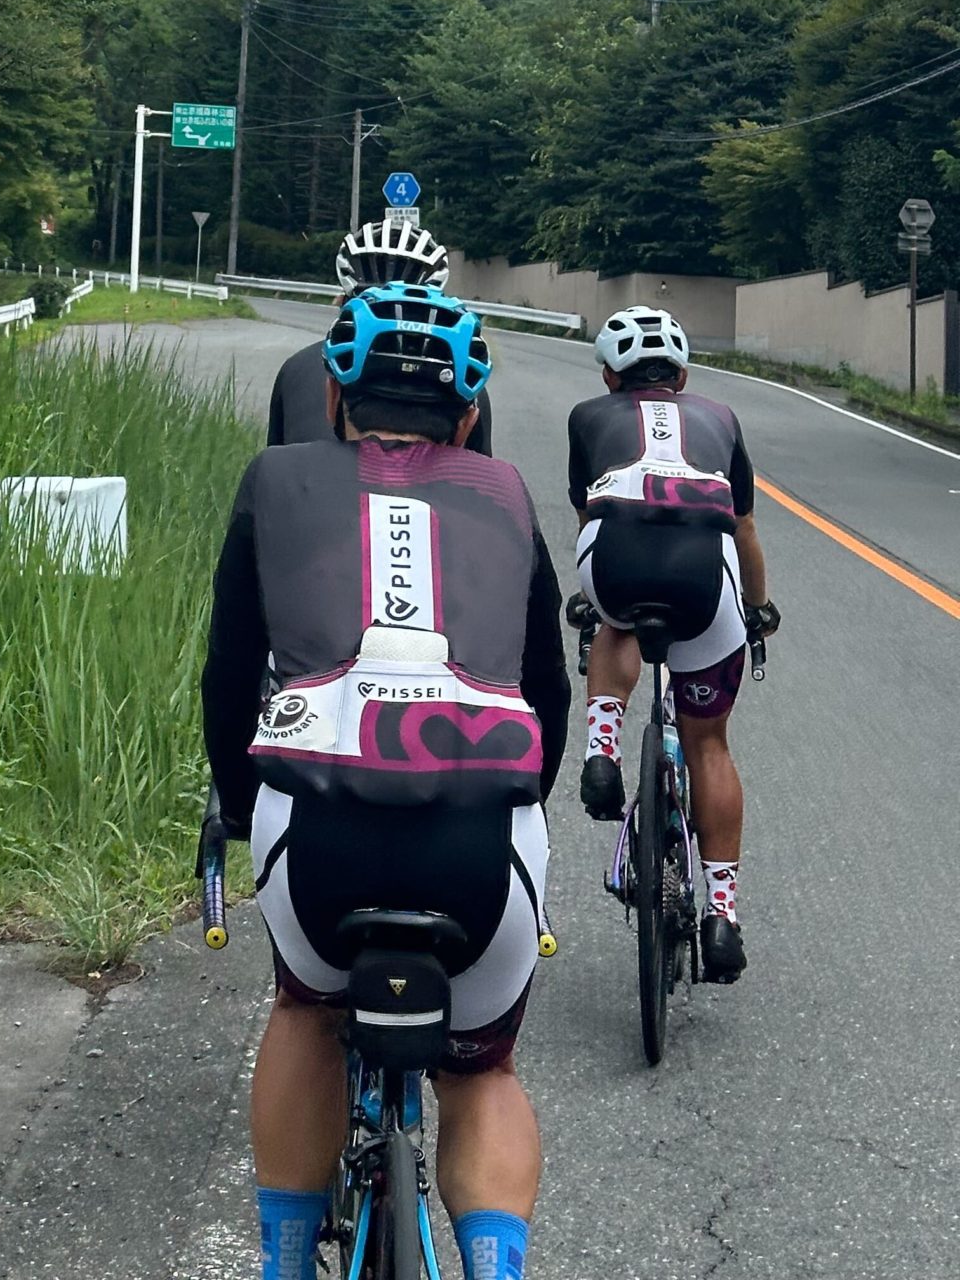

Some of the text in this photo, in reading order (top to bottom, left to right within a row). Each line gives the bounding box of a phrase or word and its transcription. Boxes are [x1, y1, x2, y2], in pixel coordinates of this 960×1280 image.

[396, 182, 407, 196] 4
[388, 505, 413, 589] PISSEI
[377, 687, 442, 699] PISSEI
[257, 711, 319, 739] nniversary
